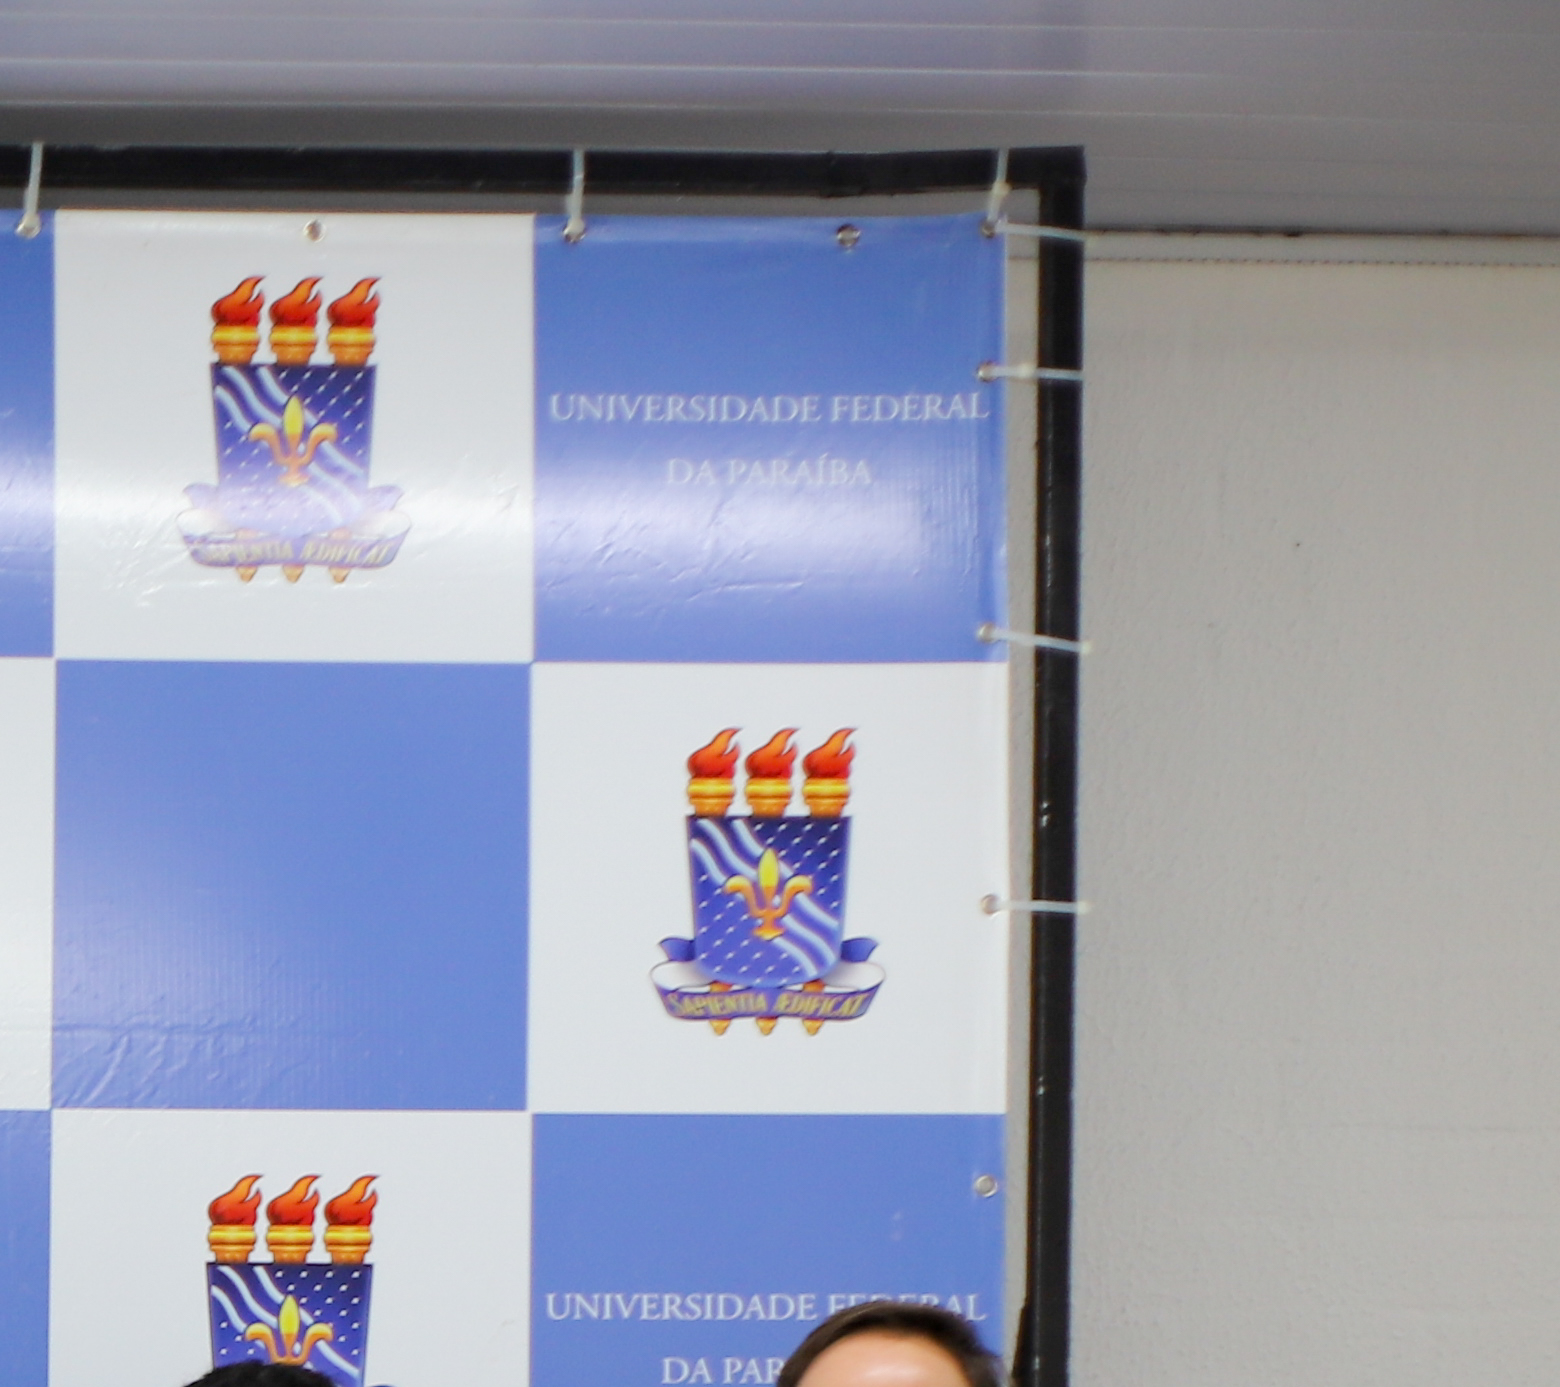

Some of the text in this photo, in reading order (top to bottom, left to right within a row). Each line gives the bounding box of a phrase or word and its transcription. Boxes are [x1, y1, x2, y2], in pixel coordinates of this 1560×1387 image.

[550, 393, 993, 423] UNIVERSIDADE FEDERAL
[666, 457, 715, 484] DA
[546, 1292, 820, 1321] UNIVERSIDADE
[661, 1356, 714, 1385] DA
